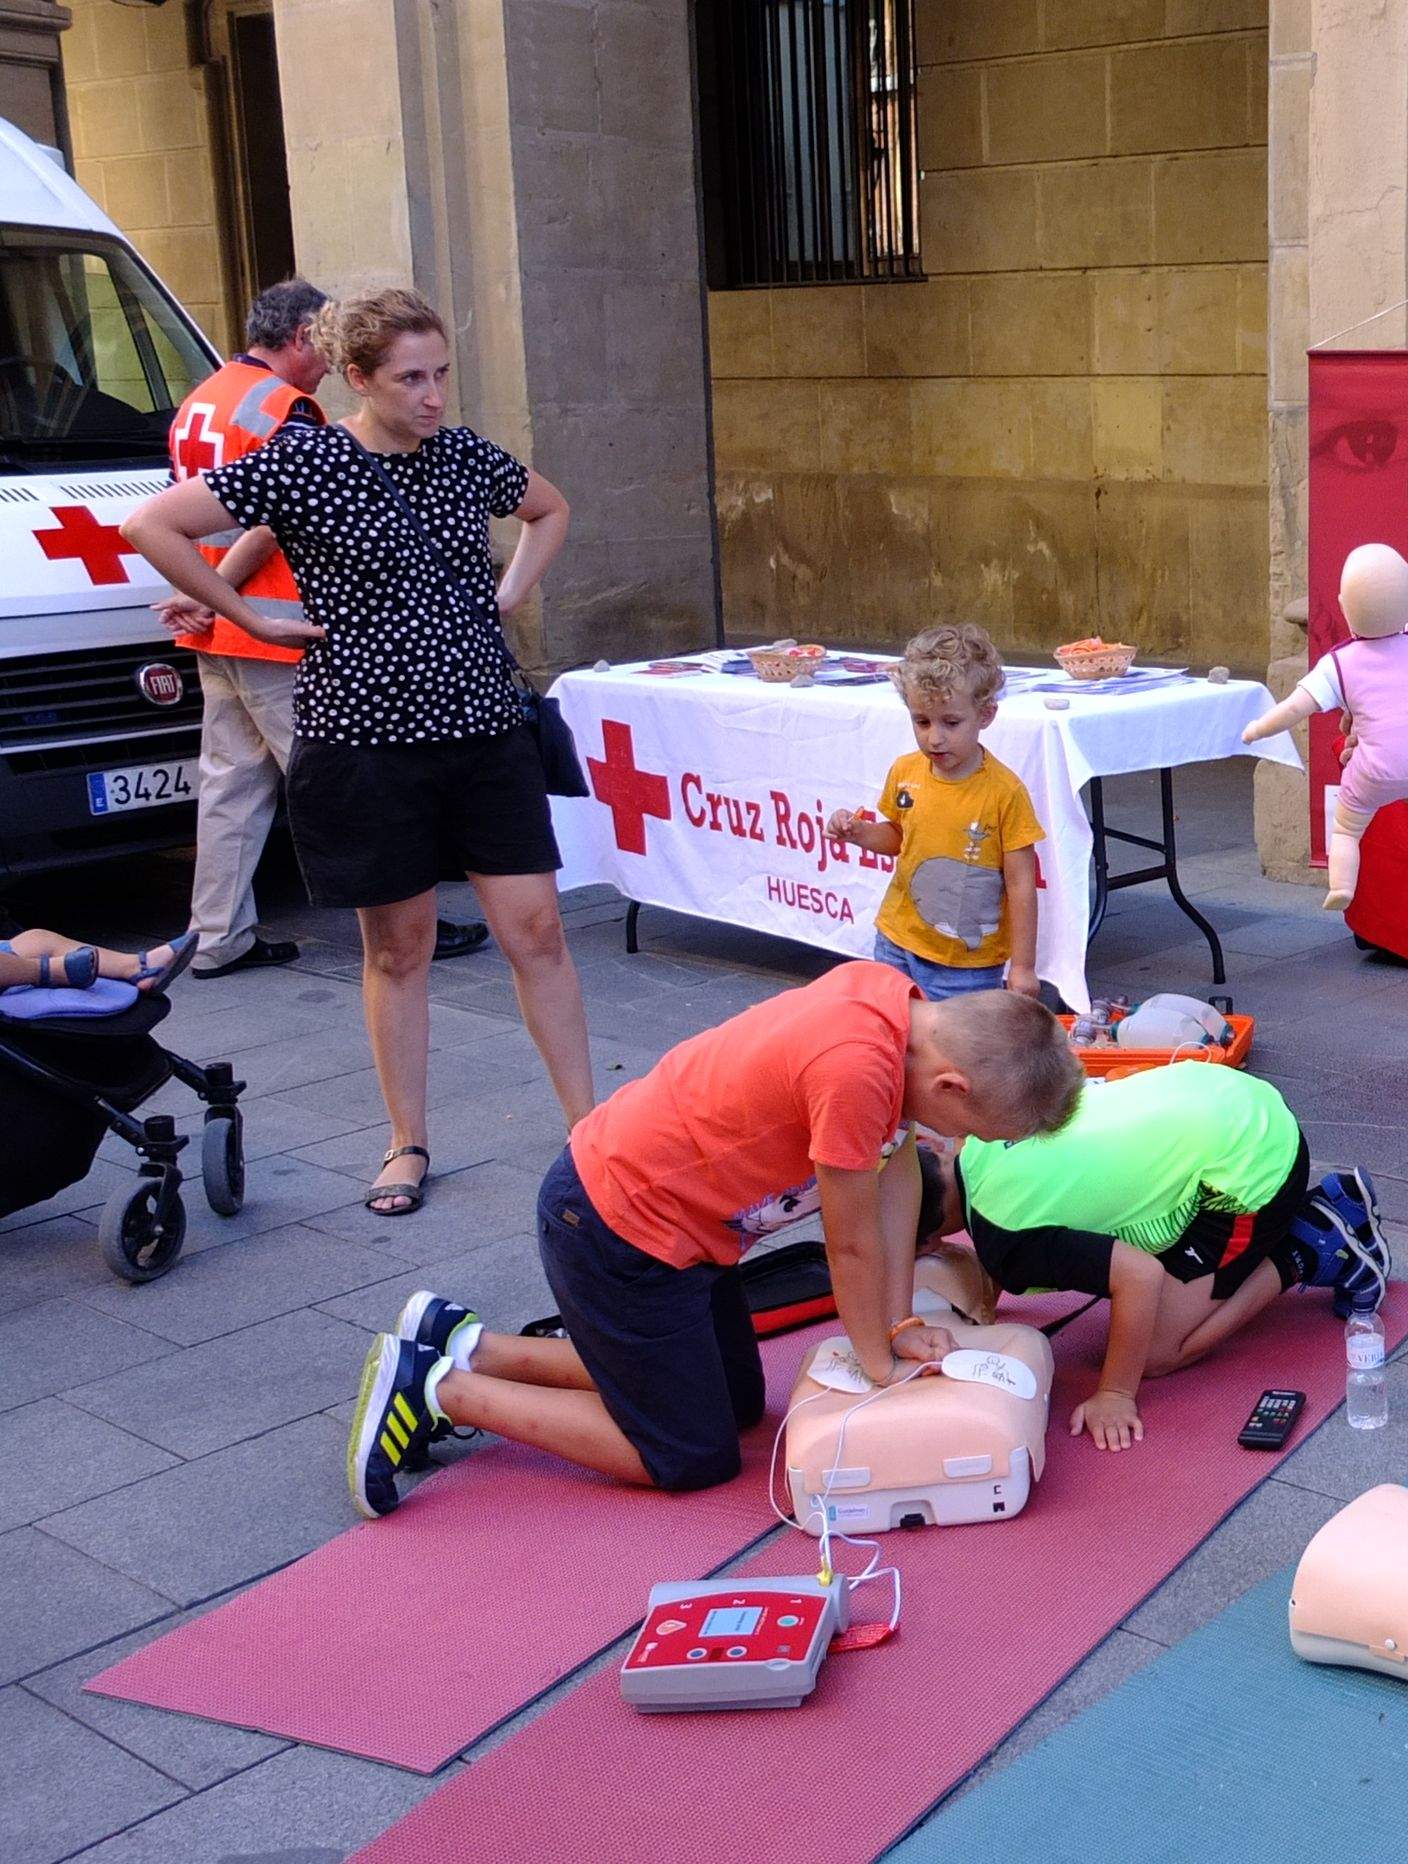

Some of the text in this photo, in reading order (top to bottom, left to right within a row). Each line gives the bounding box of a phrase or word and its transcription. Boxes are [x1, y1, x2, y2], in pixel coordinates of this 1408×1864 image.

[150, 674, 175, 695] FIAT
[112, 765, 191, 805] 3424
[680, 772, 765, 841] Cruz
[766, 875, 855, 924] HUESCA
